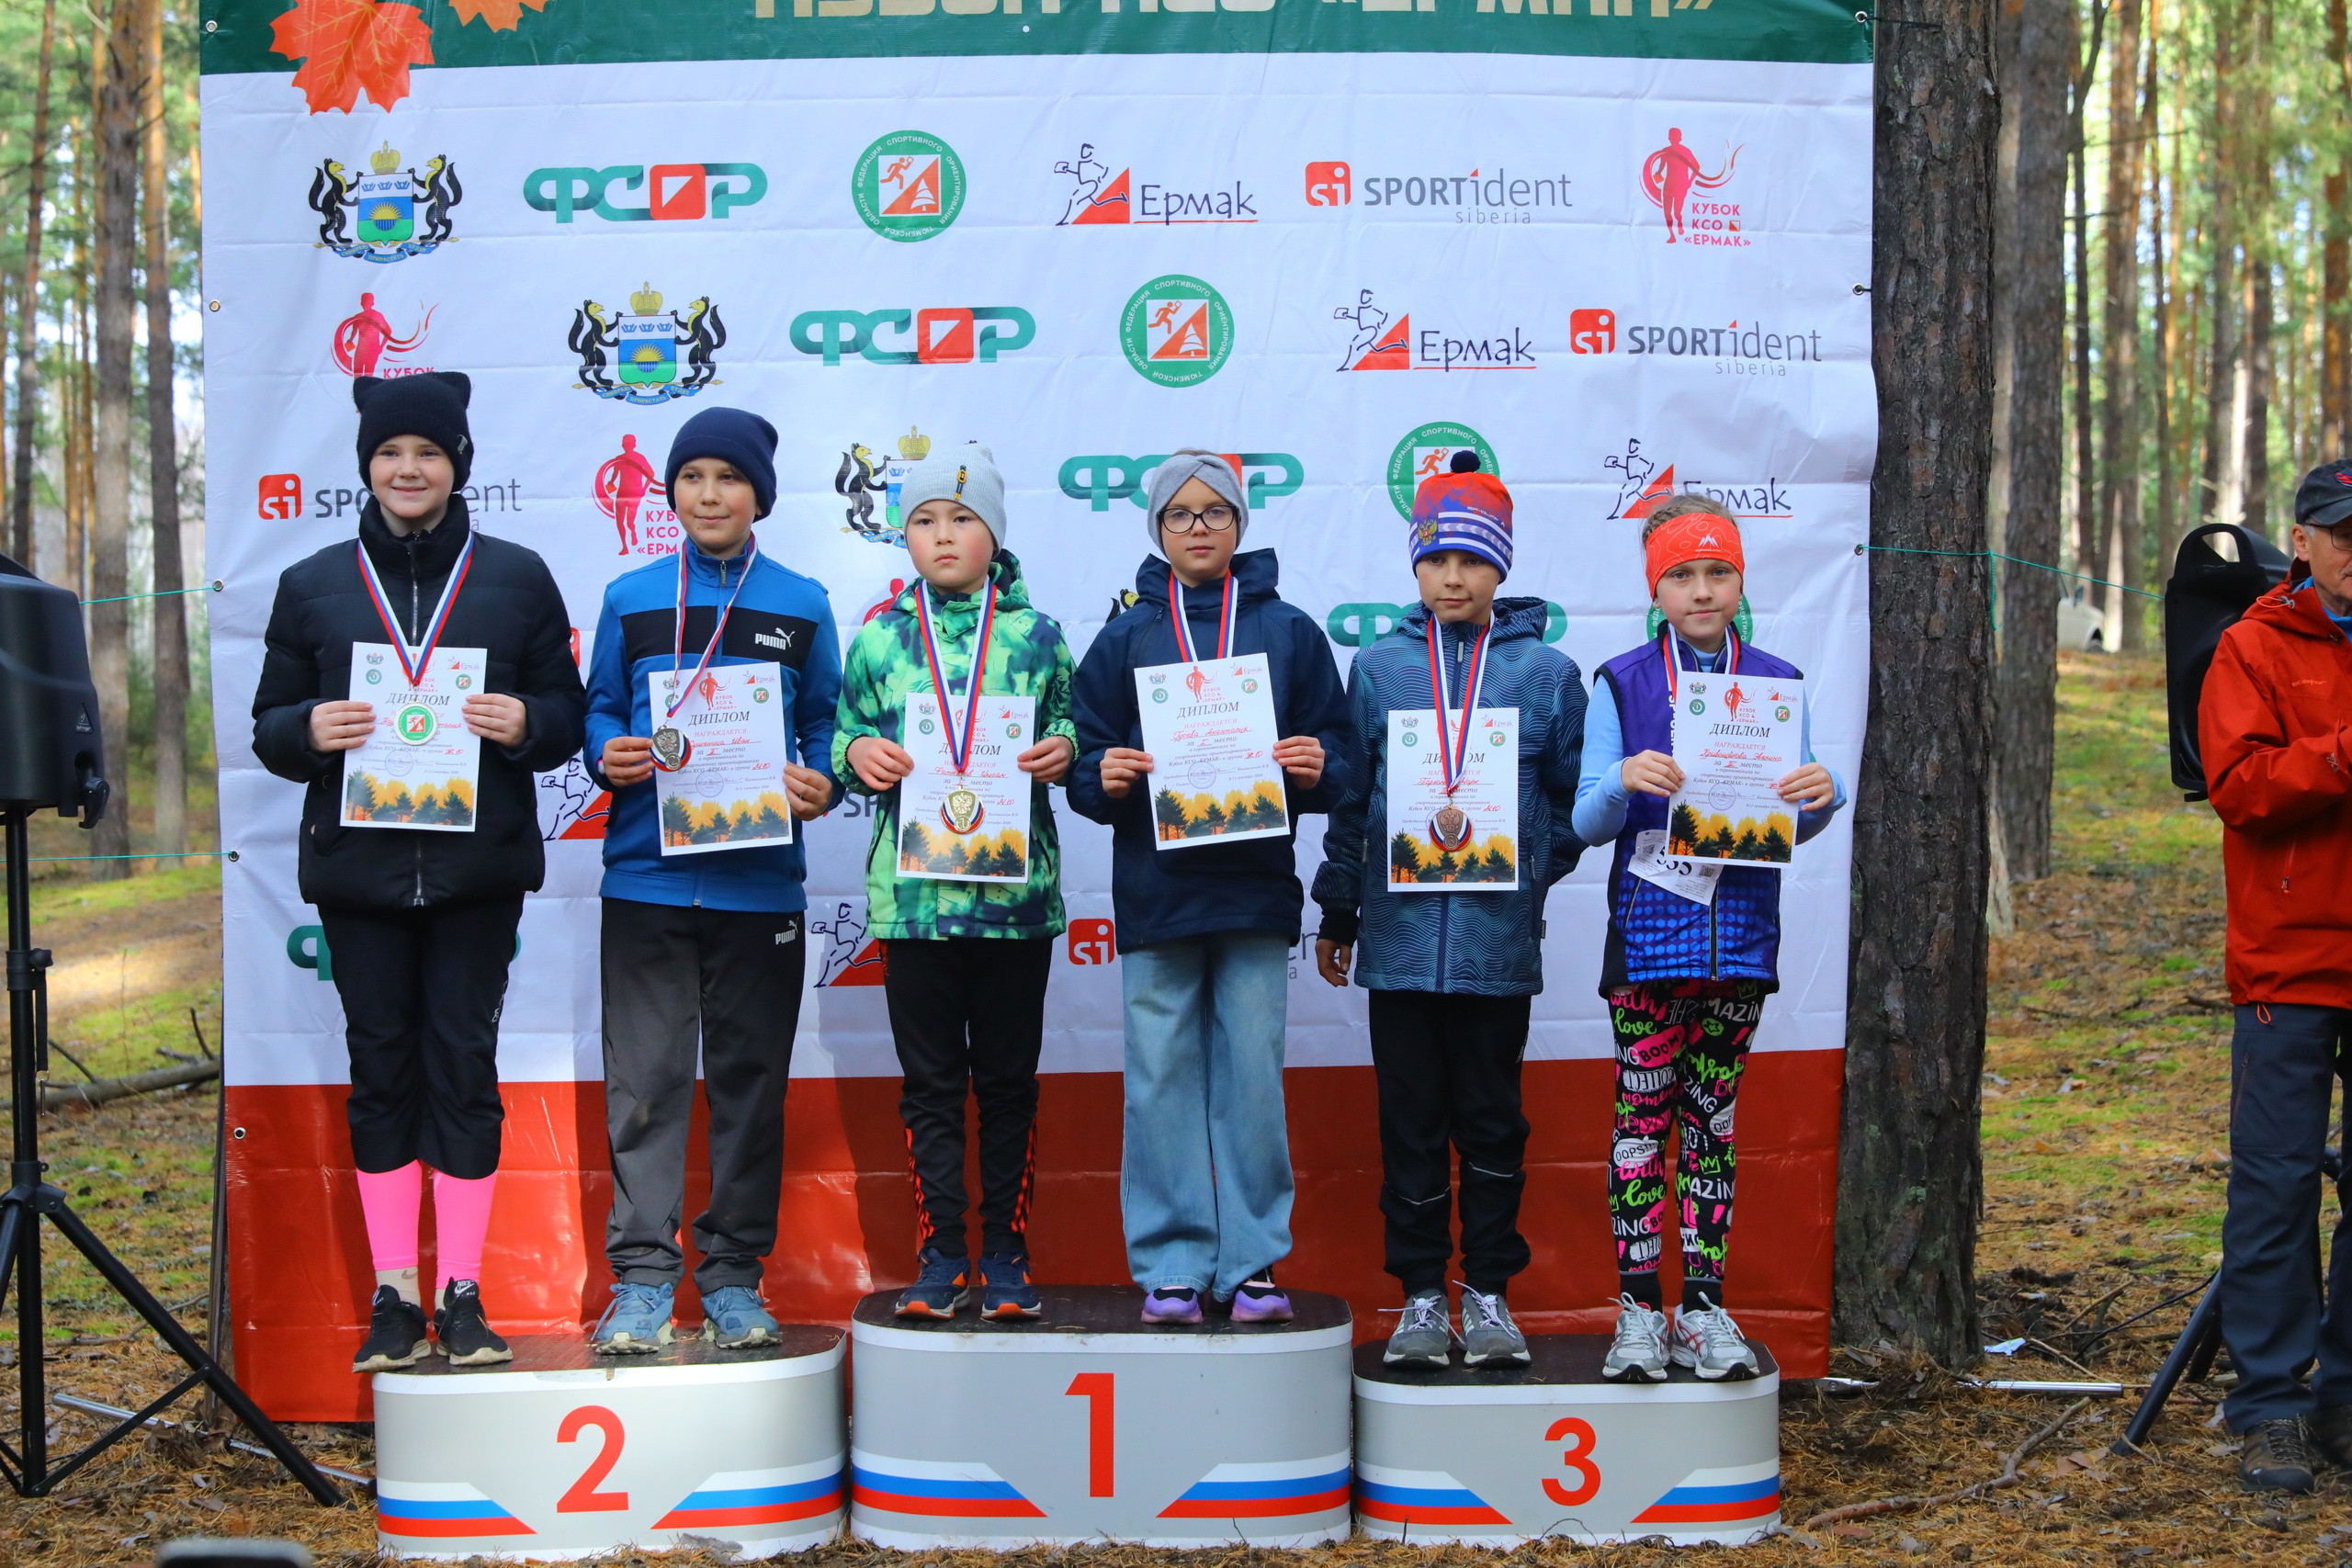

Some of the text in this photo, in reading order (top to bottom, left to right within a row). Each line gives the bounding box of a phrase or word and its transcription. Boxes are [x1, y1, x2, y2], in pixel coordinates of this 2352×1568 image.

[857, 135, 961, 237] ФЕДЕРАЦИЯ СПОРТИВНОГО ОРИЕНТИРОВАНИЯ ТЮМЕНСКОЙ ОБЛАСТИ
[1363, 168, 1573, 208] SPORTident
[1140, 181, 1257, 226] Ермак
[1692, 203, 1740, 216] КУБОК
[1455, 208, 1532, 225] siberia
[1691, 219, 1723, 230] КСО
[1684, 234, 1751, 247] «ЕРМАК»
[1125, 279, 1229, 383] ФЕДЕРАЦИЯ СПОРТИВНОГО ОРИЕНТИРОВАНИЯ ТЮМЕНСКОЙ ОБЛАСТИ
[1628, 320, 1822, 363] SPORTident
[1421, 327, 1535, 378] Ермак
[1715, 359, 1787, 378] siberia
[1393, 427, 1477, 516] ФЕДЕРАЦИЯ СПОРТИВНОГО БЛАСТИ
[646, 526, 679, 538] КСО
[755, 633, 786, 650] PUMA
[386, 693, 450, 705] ДИПЛОМ
[687, 710, 751, 727] ДИПЛОМ
[1177, 701, 1240, 719] ДИПЛОМ
[1183, 718, 1238, 729] НАГРАЖДАЕТСЯ
[1709, 723, 1771, 738] ДИПЛОМ
[695, 728, 747, 738] НАГРАЖДАЕТСЯ
[1714, 741, 1766, 750] НАГРАЖДАЕТСЯ
[775, 930, 796, 945] PUMA
[1614, 1008, 1657, 1035] love
[1622, 1179, 1667, 1207] love
[1065, 1372, 1114, 1498] 1
[556, 1405, 628, 1514] 2
[1541, 1416, 1601, 1506] 3
